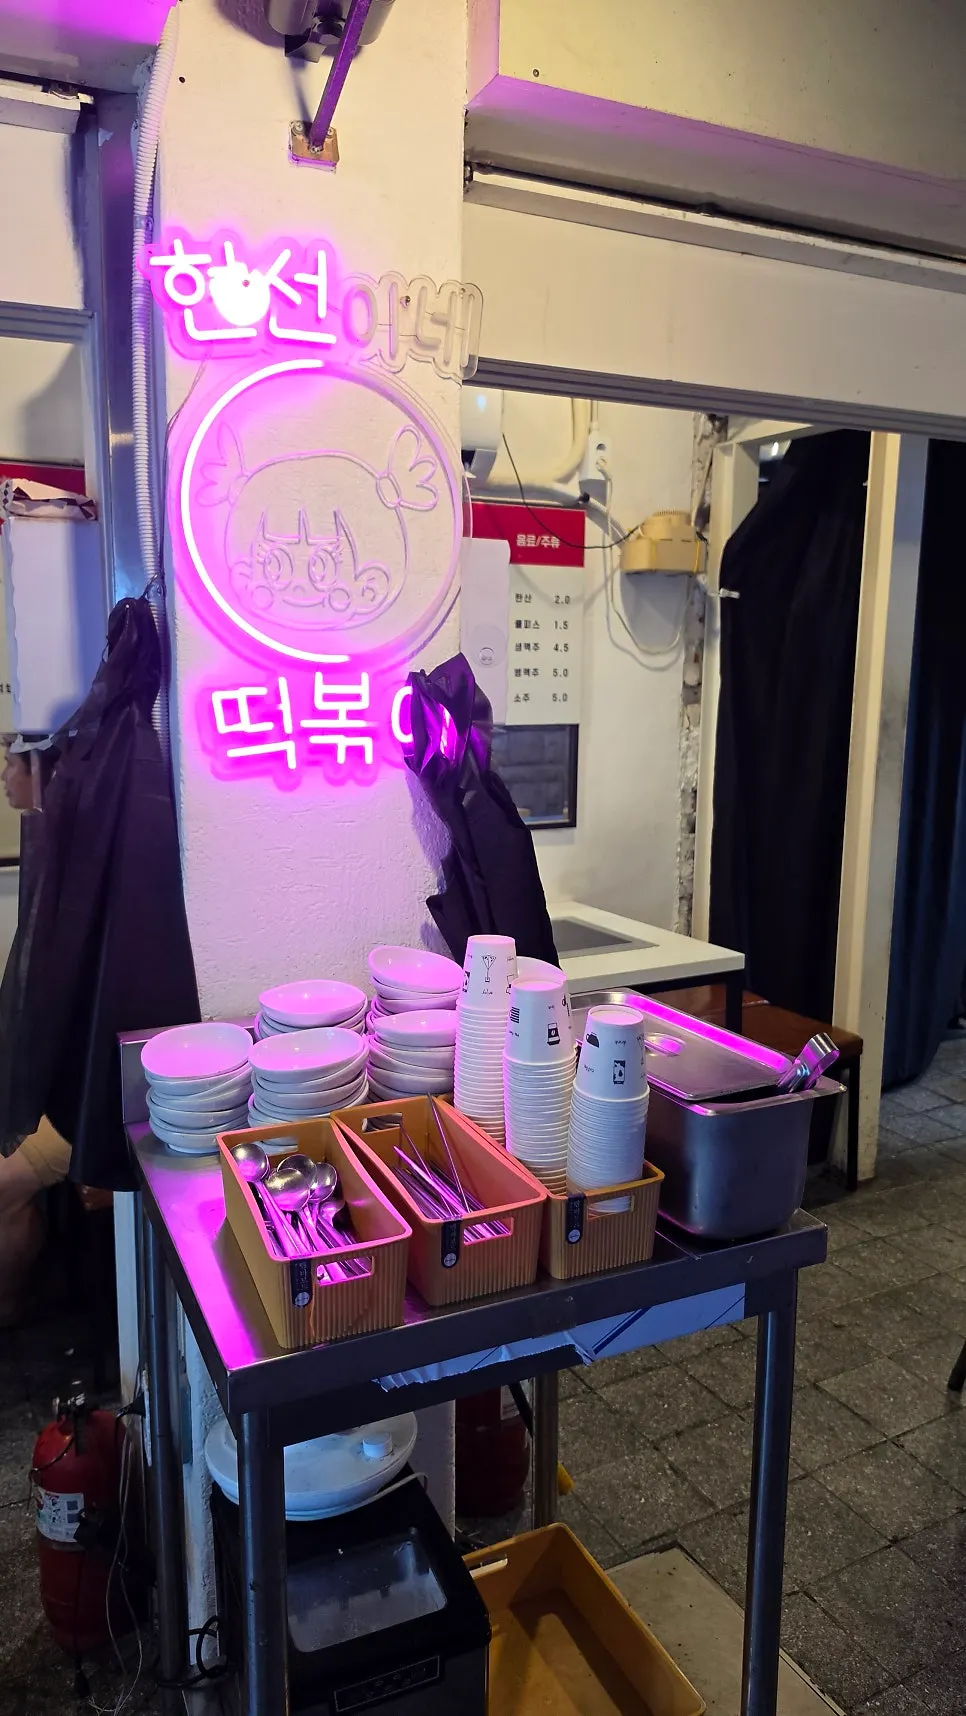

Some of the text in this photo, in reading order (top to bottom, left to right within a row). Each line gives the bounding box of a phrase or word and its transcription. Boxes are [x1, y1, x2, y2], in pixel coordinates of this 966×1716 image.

[516, 534, 561, 548] 음료/주류
[554, 595, 571, 605] 2.0
[554, 620, 569, 630] 1.5
[553, 643, 569, 653] 4.5
[552, 668, 569, 678] 5.0
[552, 693, 568, 702] 5.0
